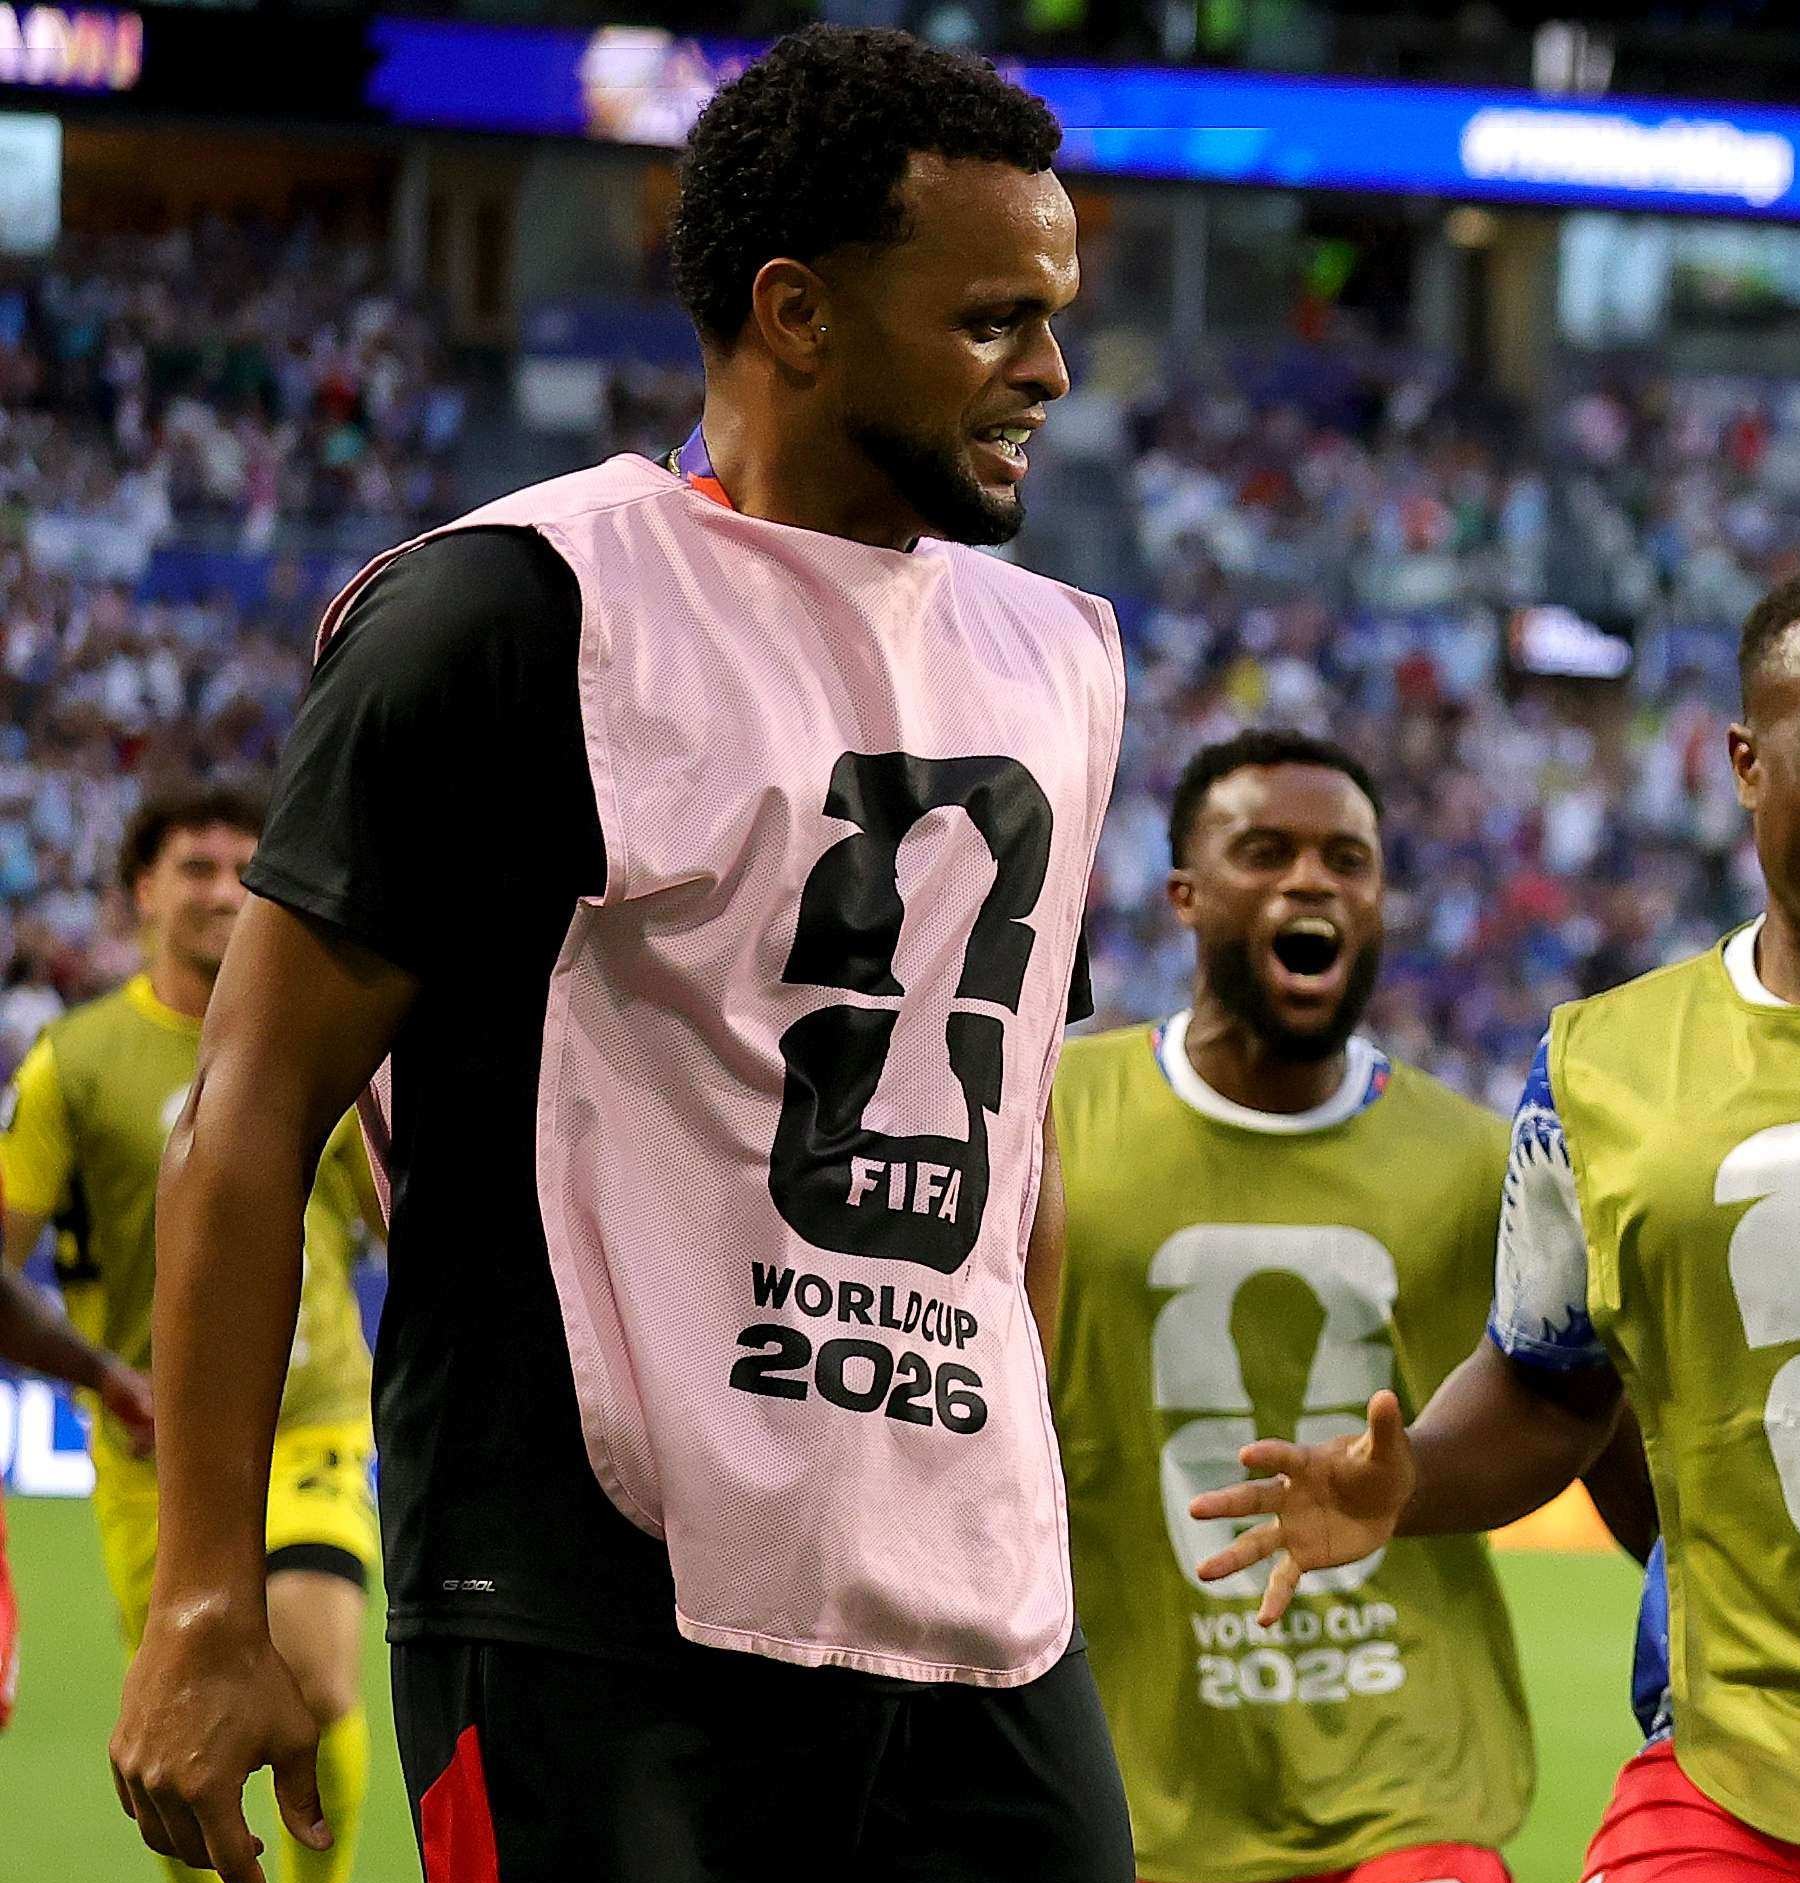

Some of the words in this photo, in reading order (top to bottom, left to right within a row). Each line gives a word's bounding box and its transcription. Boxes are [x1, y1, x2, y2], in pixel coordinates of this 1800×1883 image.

[847, 1156, 962, 1224] FIFA
[752, 1261, 922, 1334] WORLD
[921, 1298, 978, 1350] CUP
[729, 1323, 988, 1435] 2026
[1323, 1602, 1398, 1642] CUP
[1197, 1640, 1408, 1710] 2026
